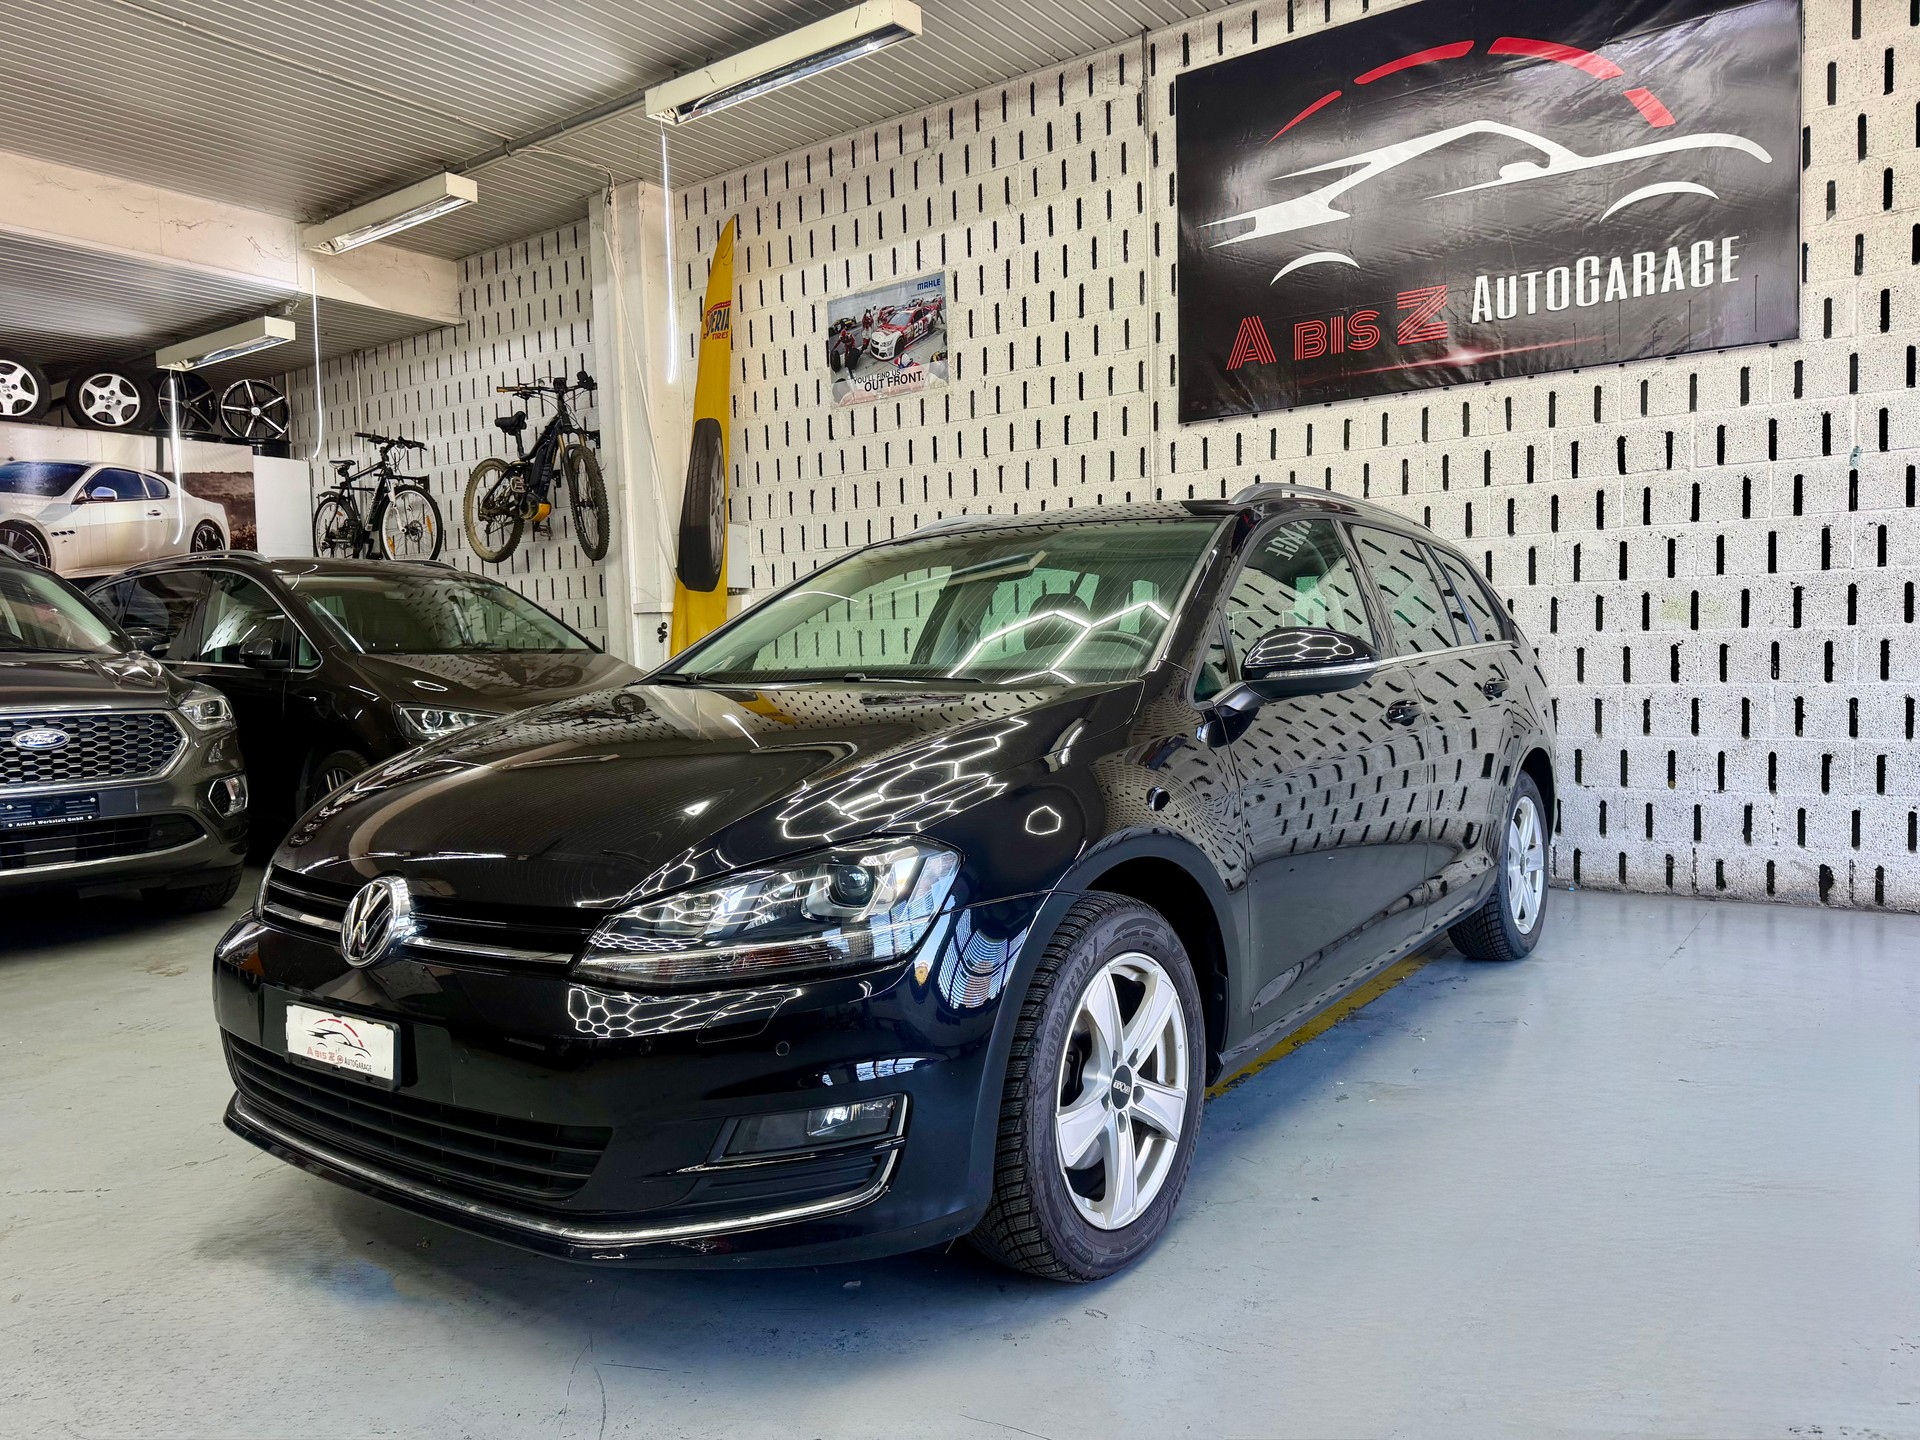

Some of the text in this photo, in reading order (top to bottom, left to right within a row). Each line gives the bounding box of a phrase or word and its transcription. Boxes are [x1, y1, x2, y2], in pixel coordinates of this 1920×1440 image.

[917, 278, 941, 291] MAHLE
[1226, 235, 1740, 371] A BIS Z AUTOGARAGE
[914, 320, 924, 337] 29
[712, 331, 729, 340] TIRES
[877, 371, 890, 380] FIND
[891, 369, 901, 377] US
[864, 371, 924, 392] OUT FRONT.
[21, 732, 61, 745] Ford
[16, 819, 36, 827] Arnold
[37, 818, 66, 826] Werkstatt
[307, 1046, 314, 1056] A
[314, 1050, 327, 1060] BIS
[328, 1051, 336, 1061] Z
